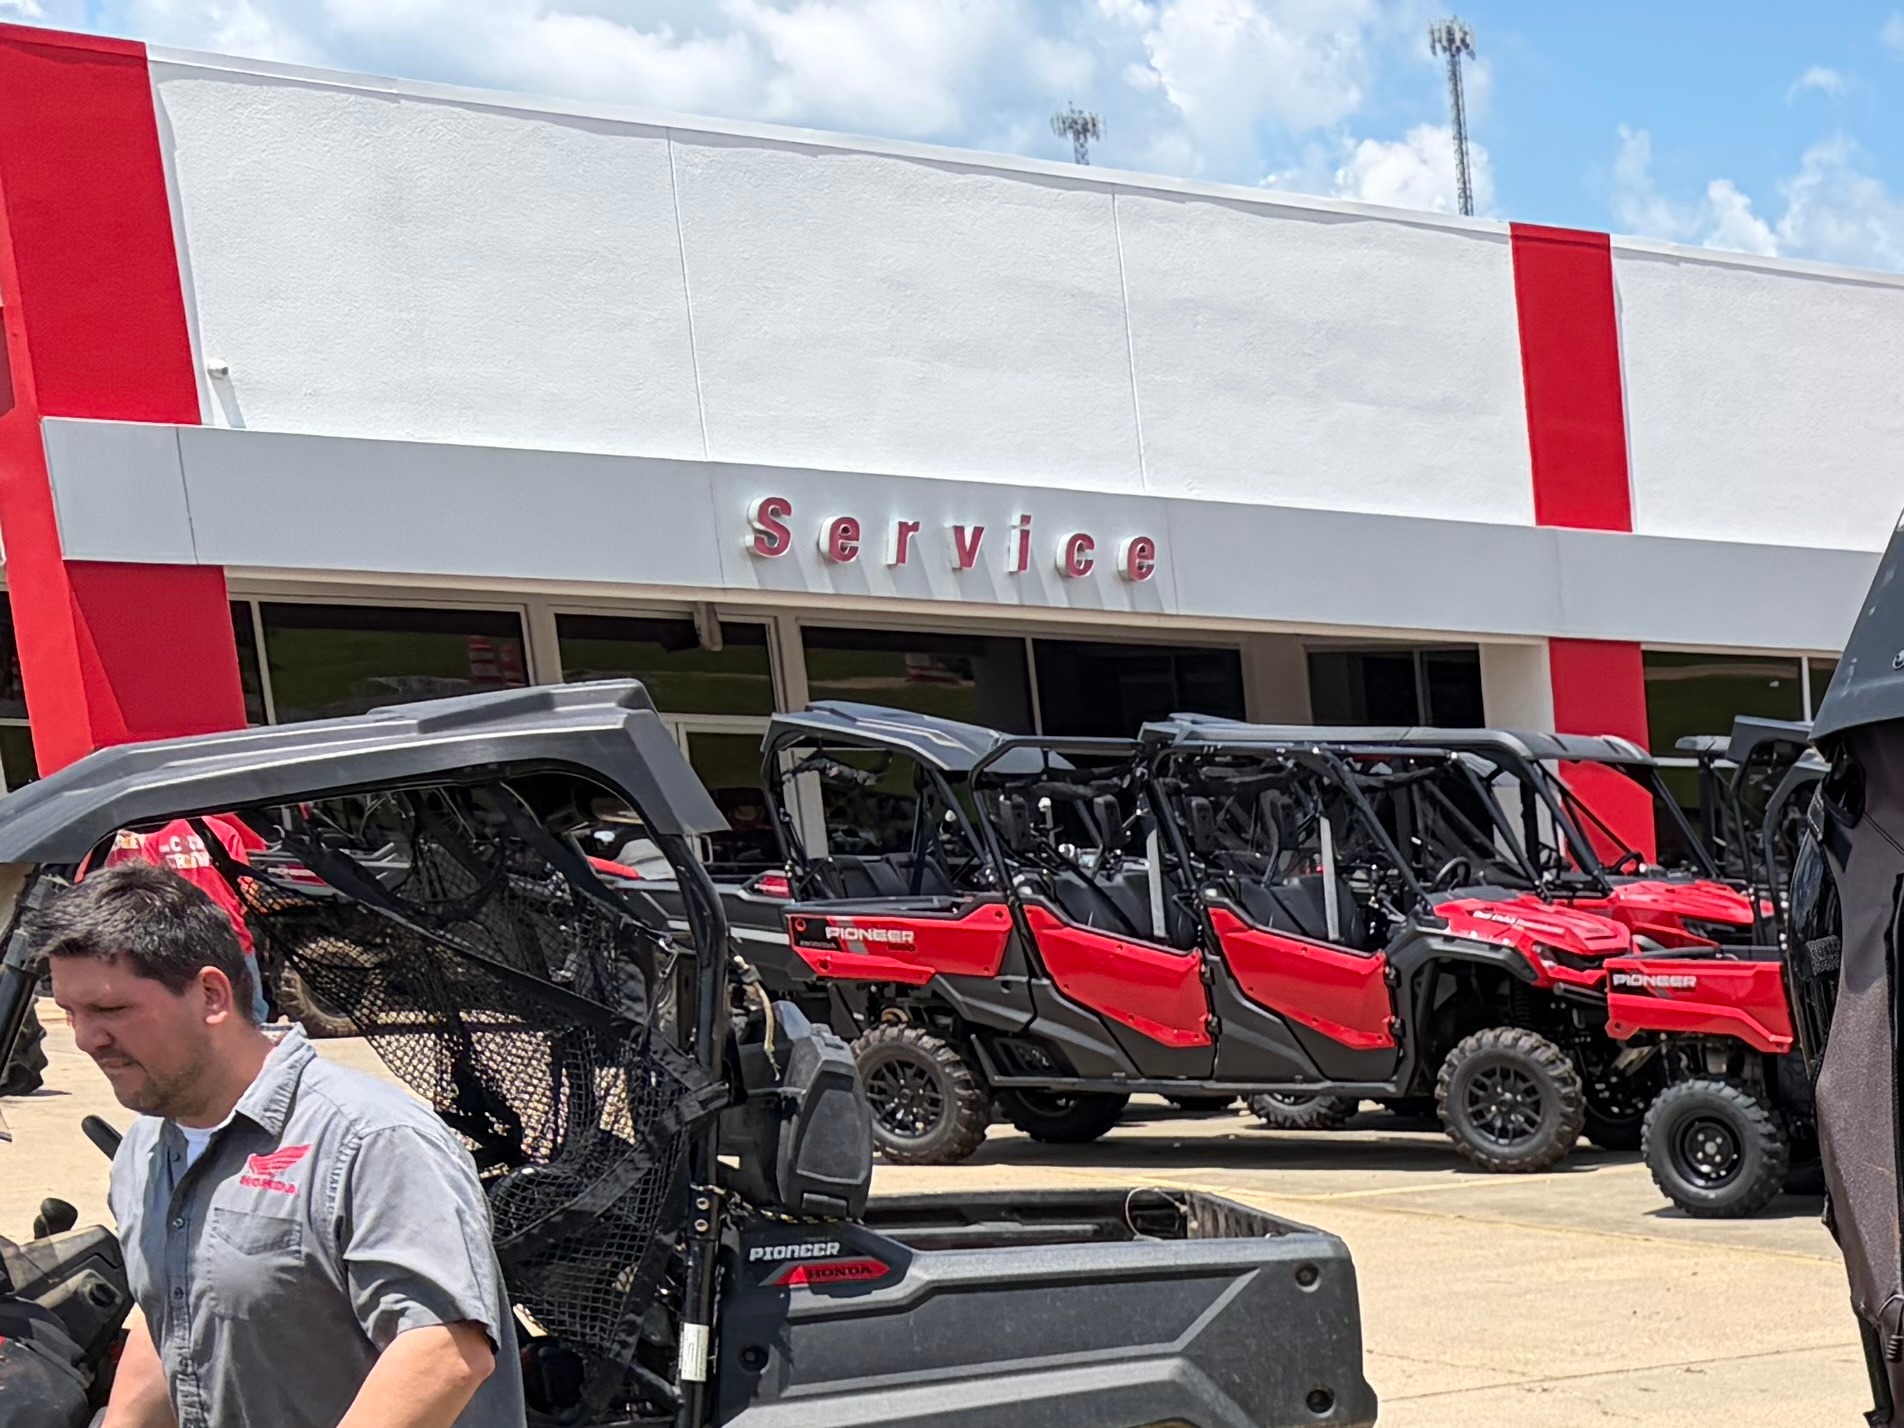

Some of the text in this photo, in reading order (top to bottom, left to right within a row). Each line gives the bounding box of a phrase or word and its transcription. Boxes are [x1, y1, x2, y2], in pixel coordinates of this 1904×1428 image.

[745, 496, 1156, 583] Service
[825, 927, 915, 944] PIONEER
[1613, 974, 1697, 988] PIONEER
[749, 1242, 841, 1262] PIONEER
[807, 1266, 873, 1279] HONDA
